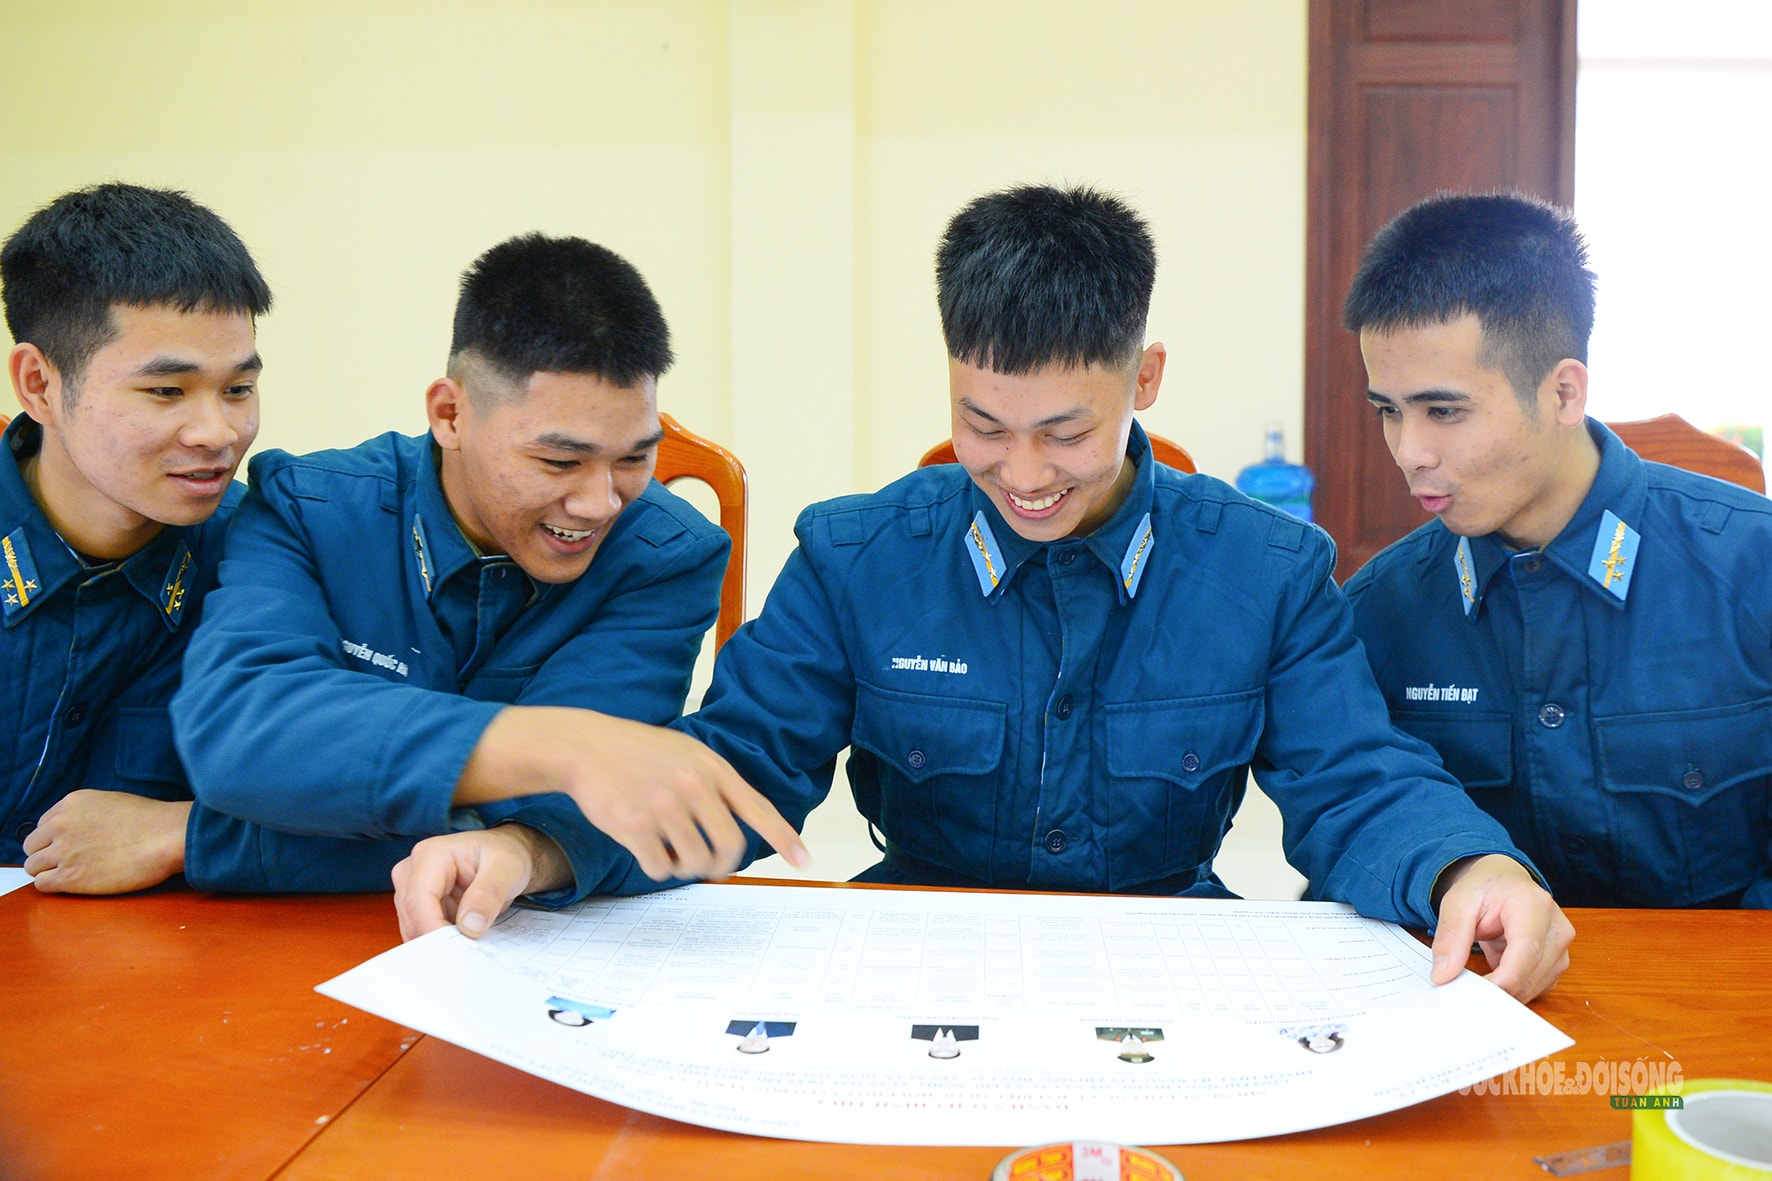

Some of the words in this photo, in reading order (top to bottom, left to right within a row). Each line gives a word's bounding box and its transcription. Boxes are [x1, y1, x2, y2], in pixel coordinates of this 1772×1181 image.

[929, 657, 948, 673] VĂN
[949, 658, 968, 675] BẢO
[1405, 683, 1440, 701] NGUYỄN
[1440, 683, 1460, 702] TIẾN
[1460, 687, 1479, 704] ĐẠT
